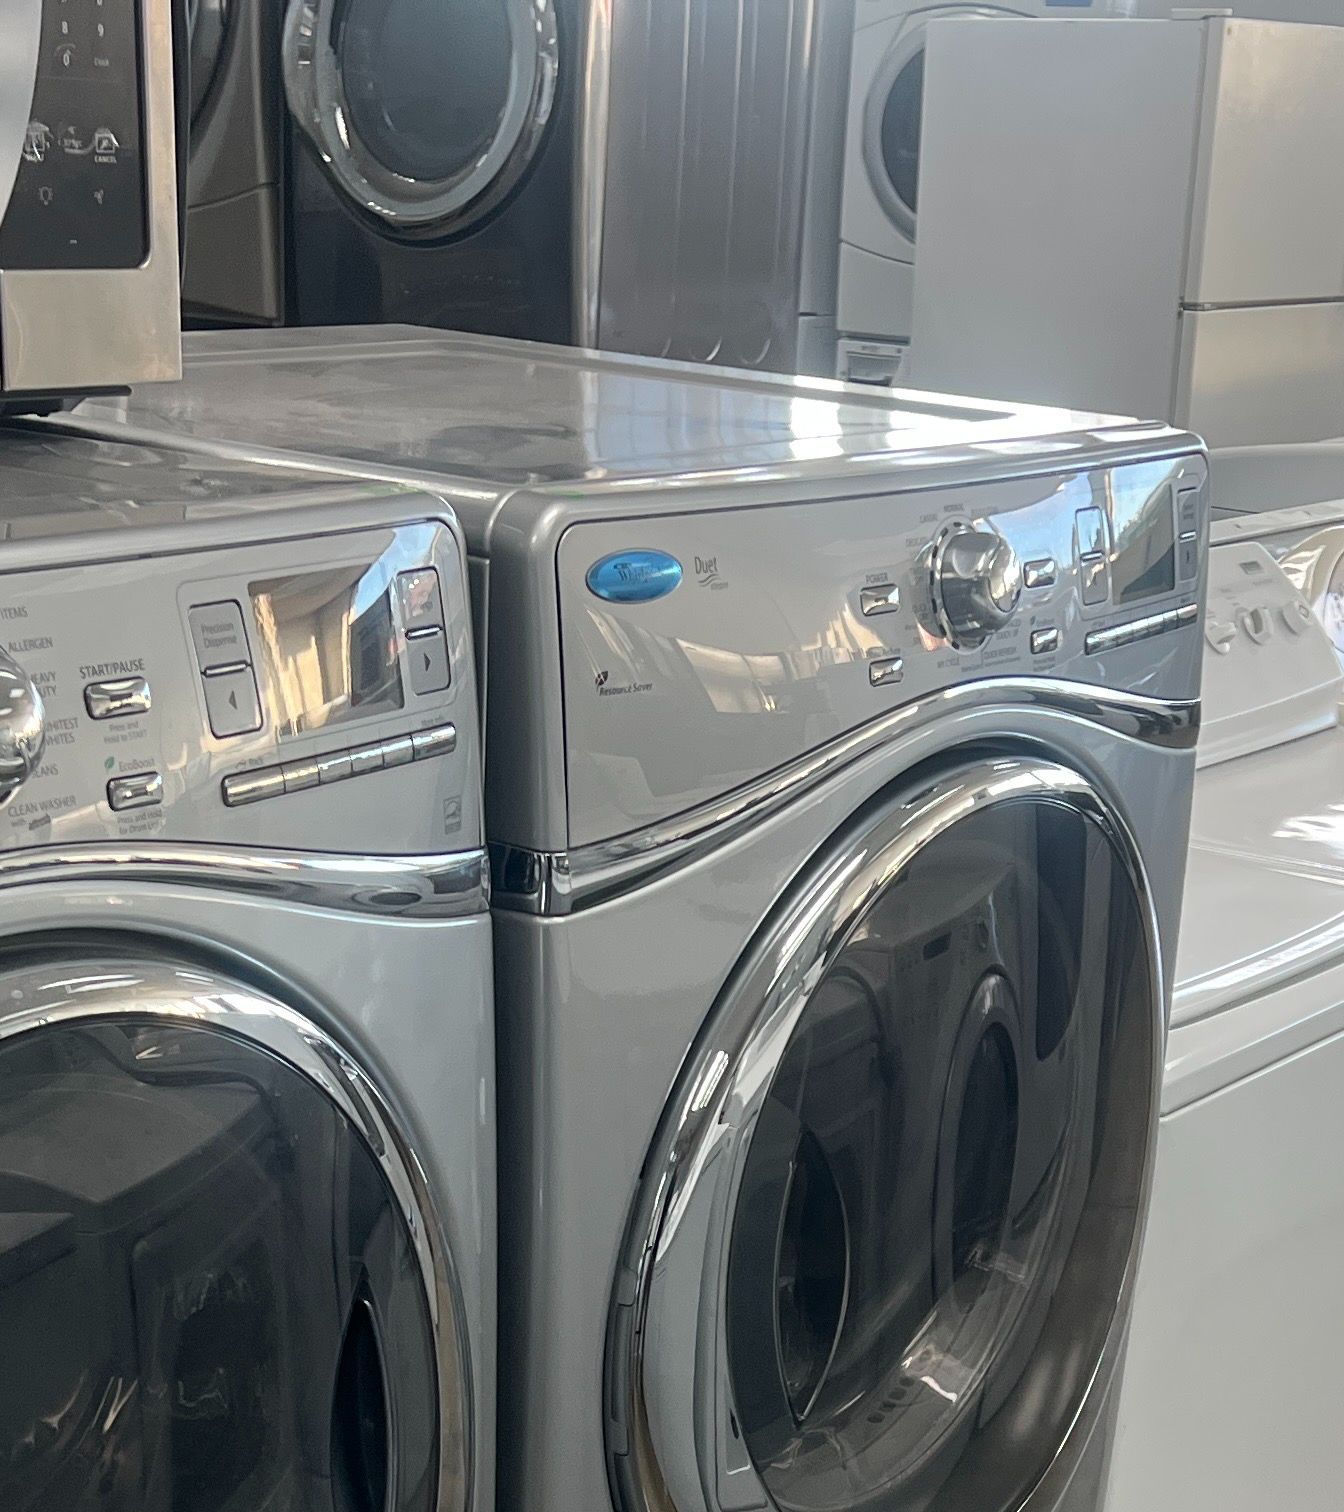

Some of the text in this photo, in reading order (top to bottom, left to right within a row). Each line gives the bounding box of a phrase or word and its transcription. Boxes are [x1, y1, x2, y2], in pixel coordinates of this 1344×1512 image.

[694, 556, 719, 575] Duet
[0, 605, 28, 620] ITEMS
[8, 636, 54, 652] ALLERGEN
[79, 658, 146, 680] START/PAUSE
[599, 681, 653, 697] Resource Saver
[32, 764, 59, 779] EANS
[118, 758, 155, 772] EcoBoost
[7, 801, 38, 818] CLEAN
